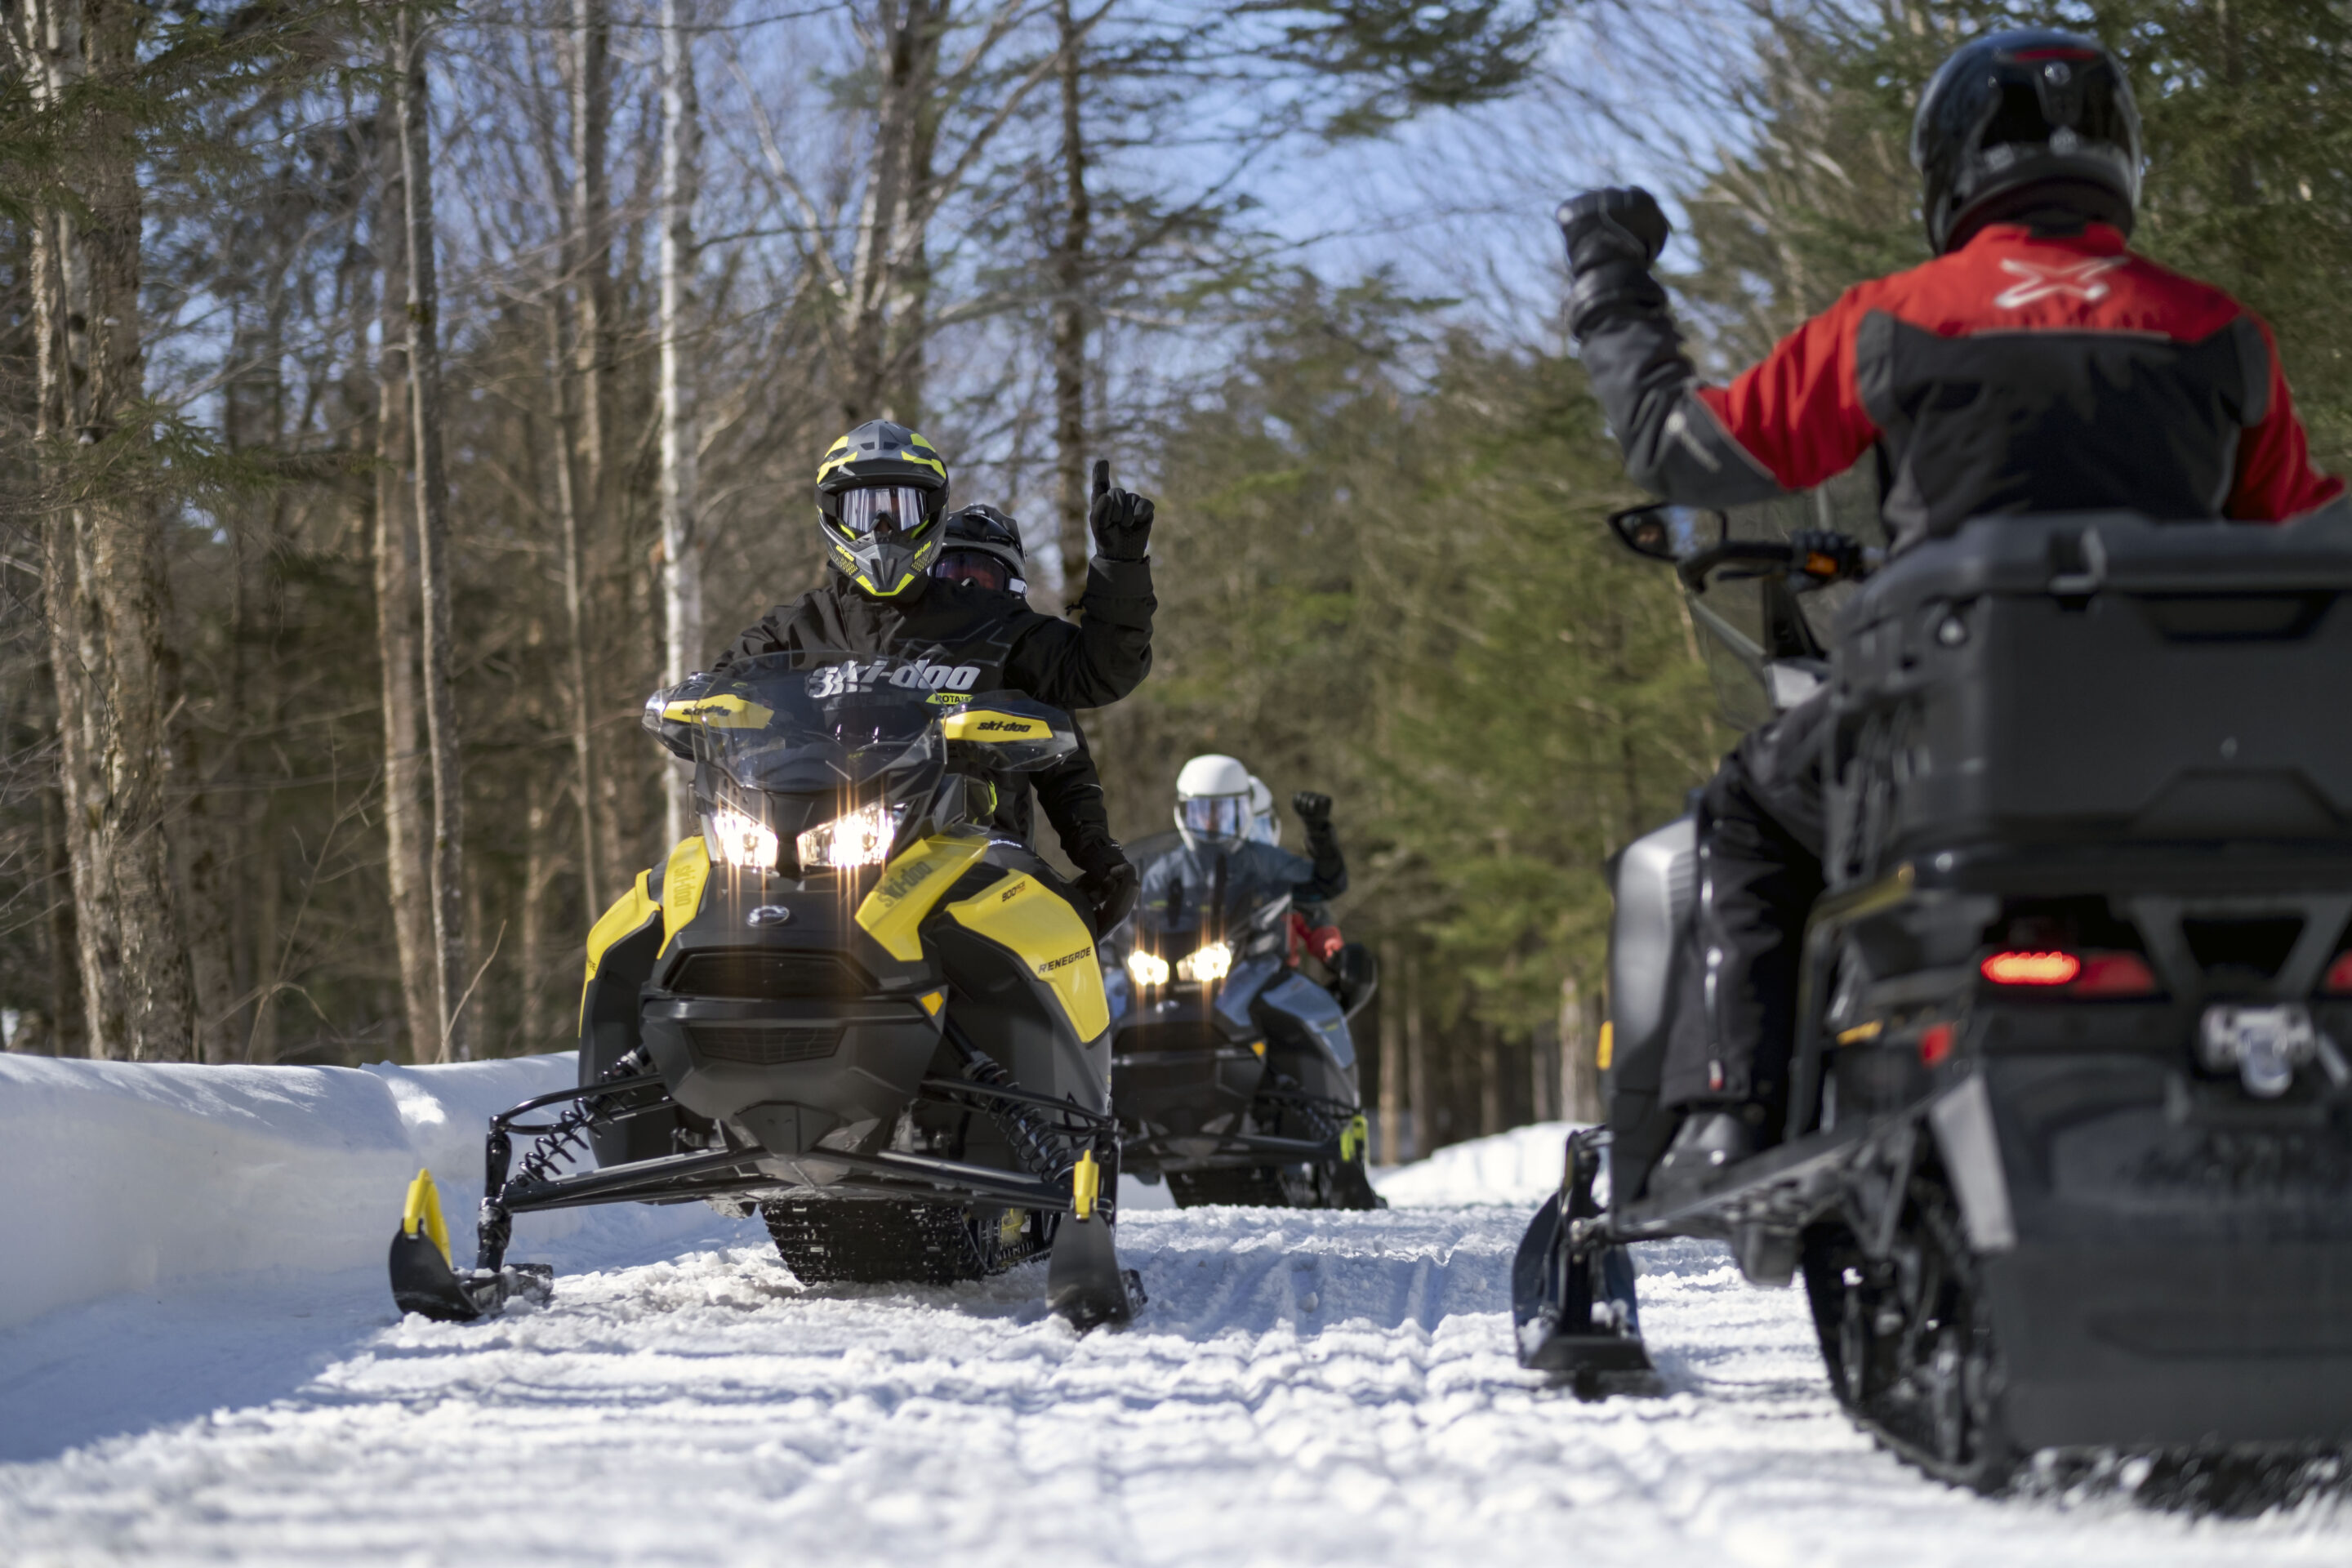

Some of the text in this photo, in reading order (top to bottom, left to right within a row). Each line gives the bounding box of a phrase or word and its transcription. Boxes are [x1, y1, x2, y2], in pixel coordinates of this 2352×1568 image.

[977, 720, 1031, 733] ski-doo
[674, 865, 696, 907] ski-doo
[876, 861, 933, 908] ski-doo
[1038, 947, 1092, 974] RENEGADE
